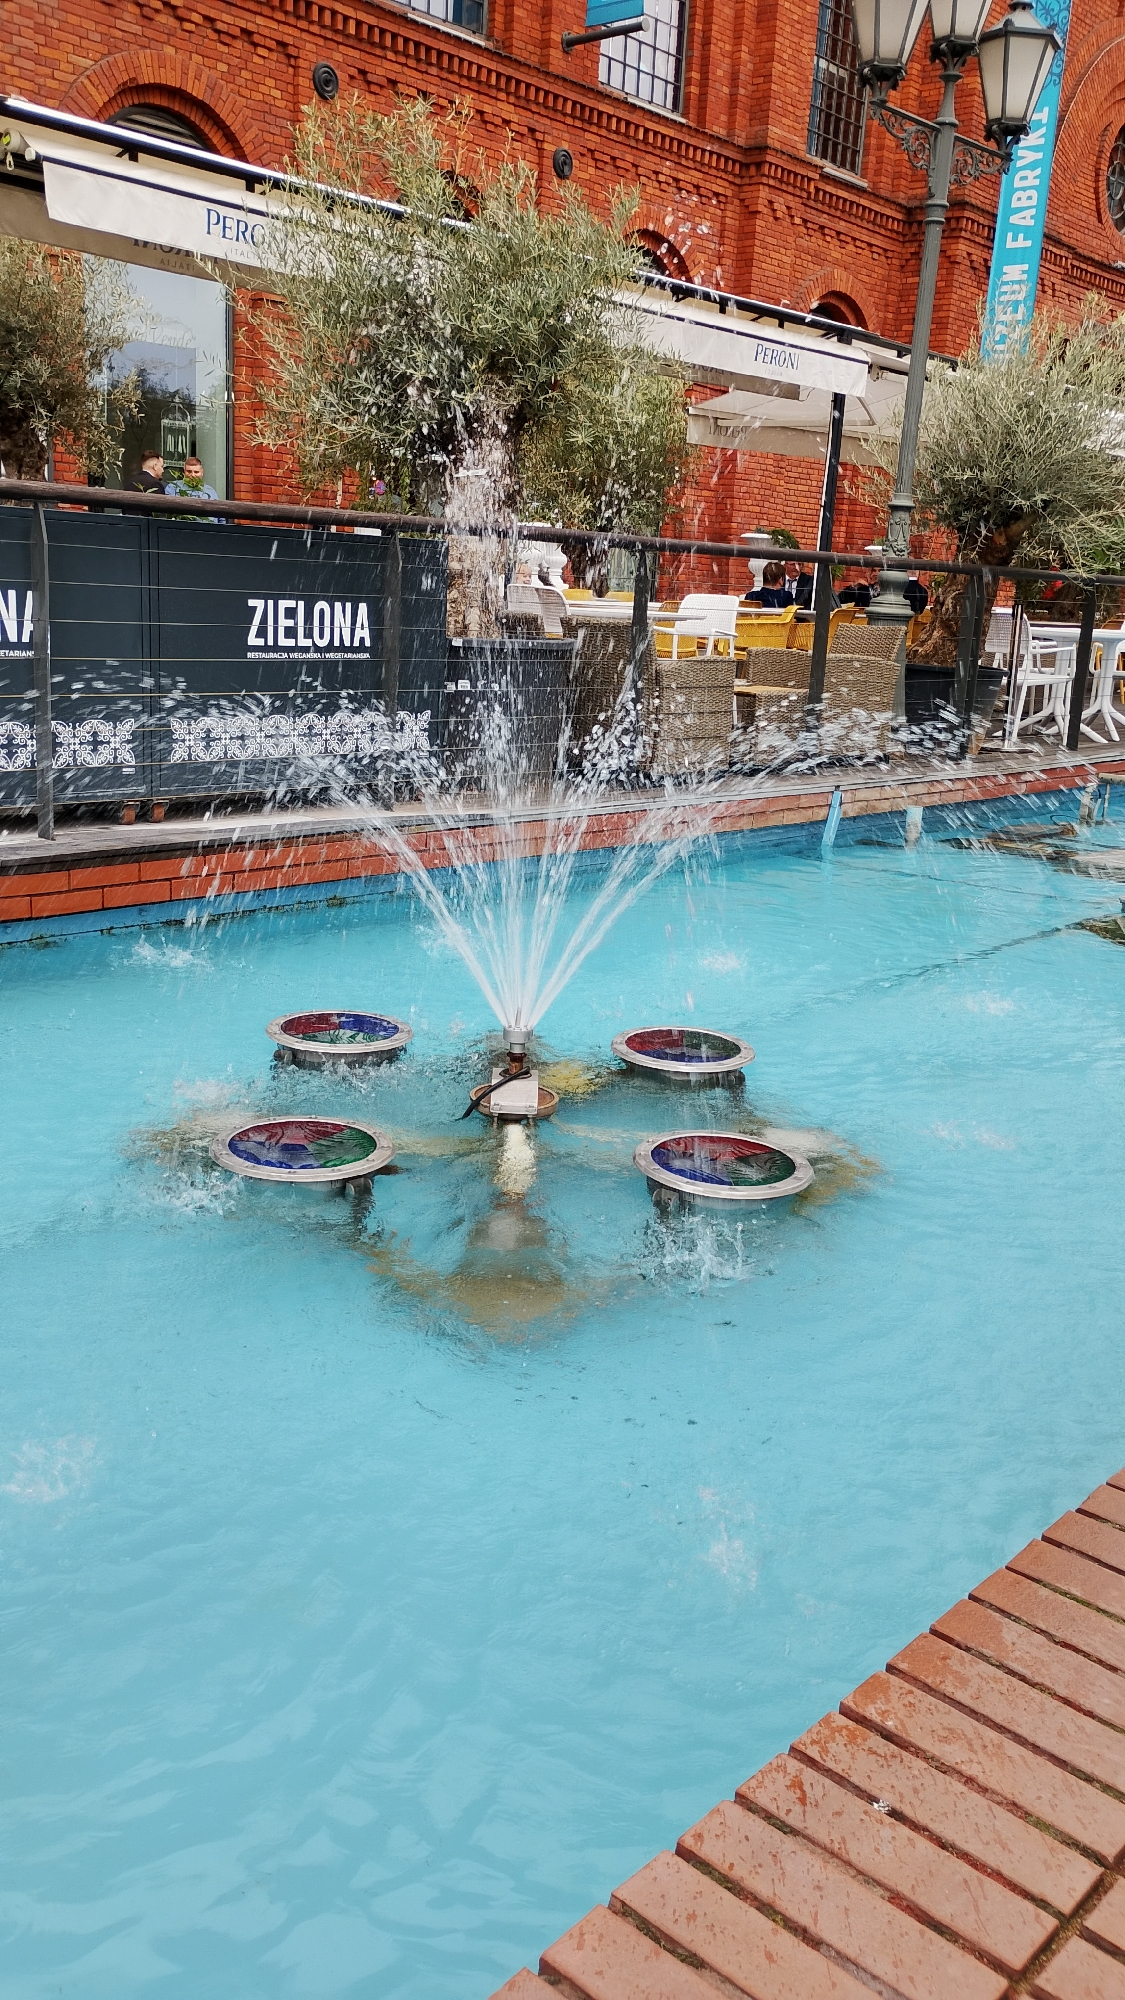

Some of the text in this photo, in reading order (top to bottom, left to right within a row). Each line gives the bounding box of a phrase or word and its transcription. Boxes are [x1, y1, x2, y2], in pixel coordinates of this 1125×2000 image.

[206, 207, 266, 248] PERO
[754, 343, 800, 370] PERONI
[247, 599, 371, 647] ZIELONA
